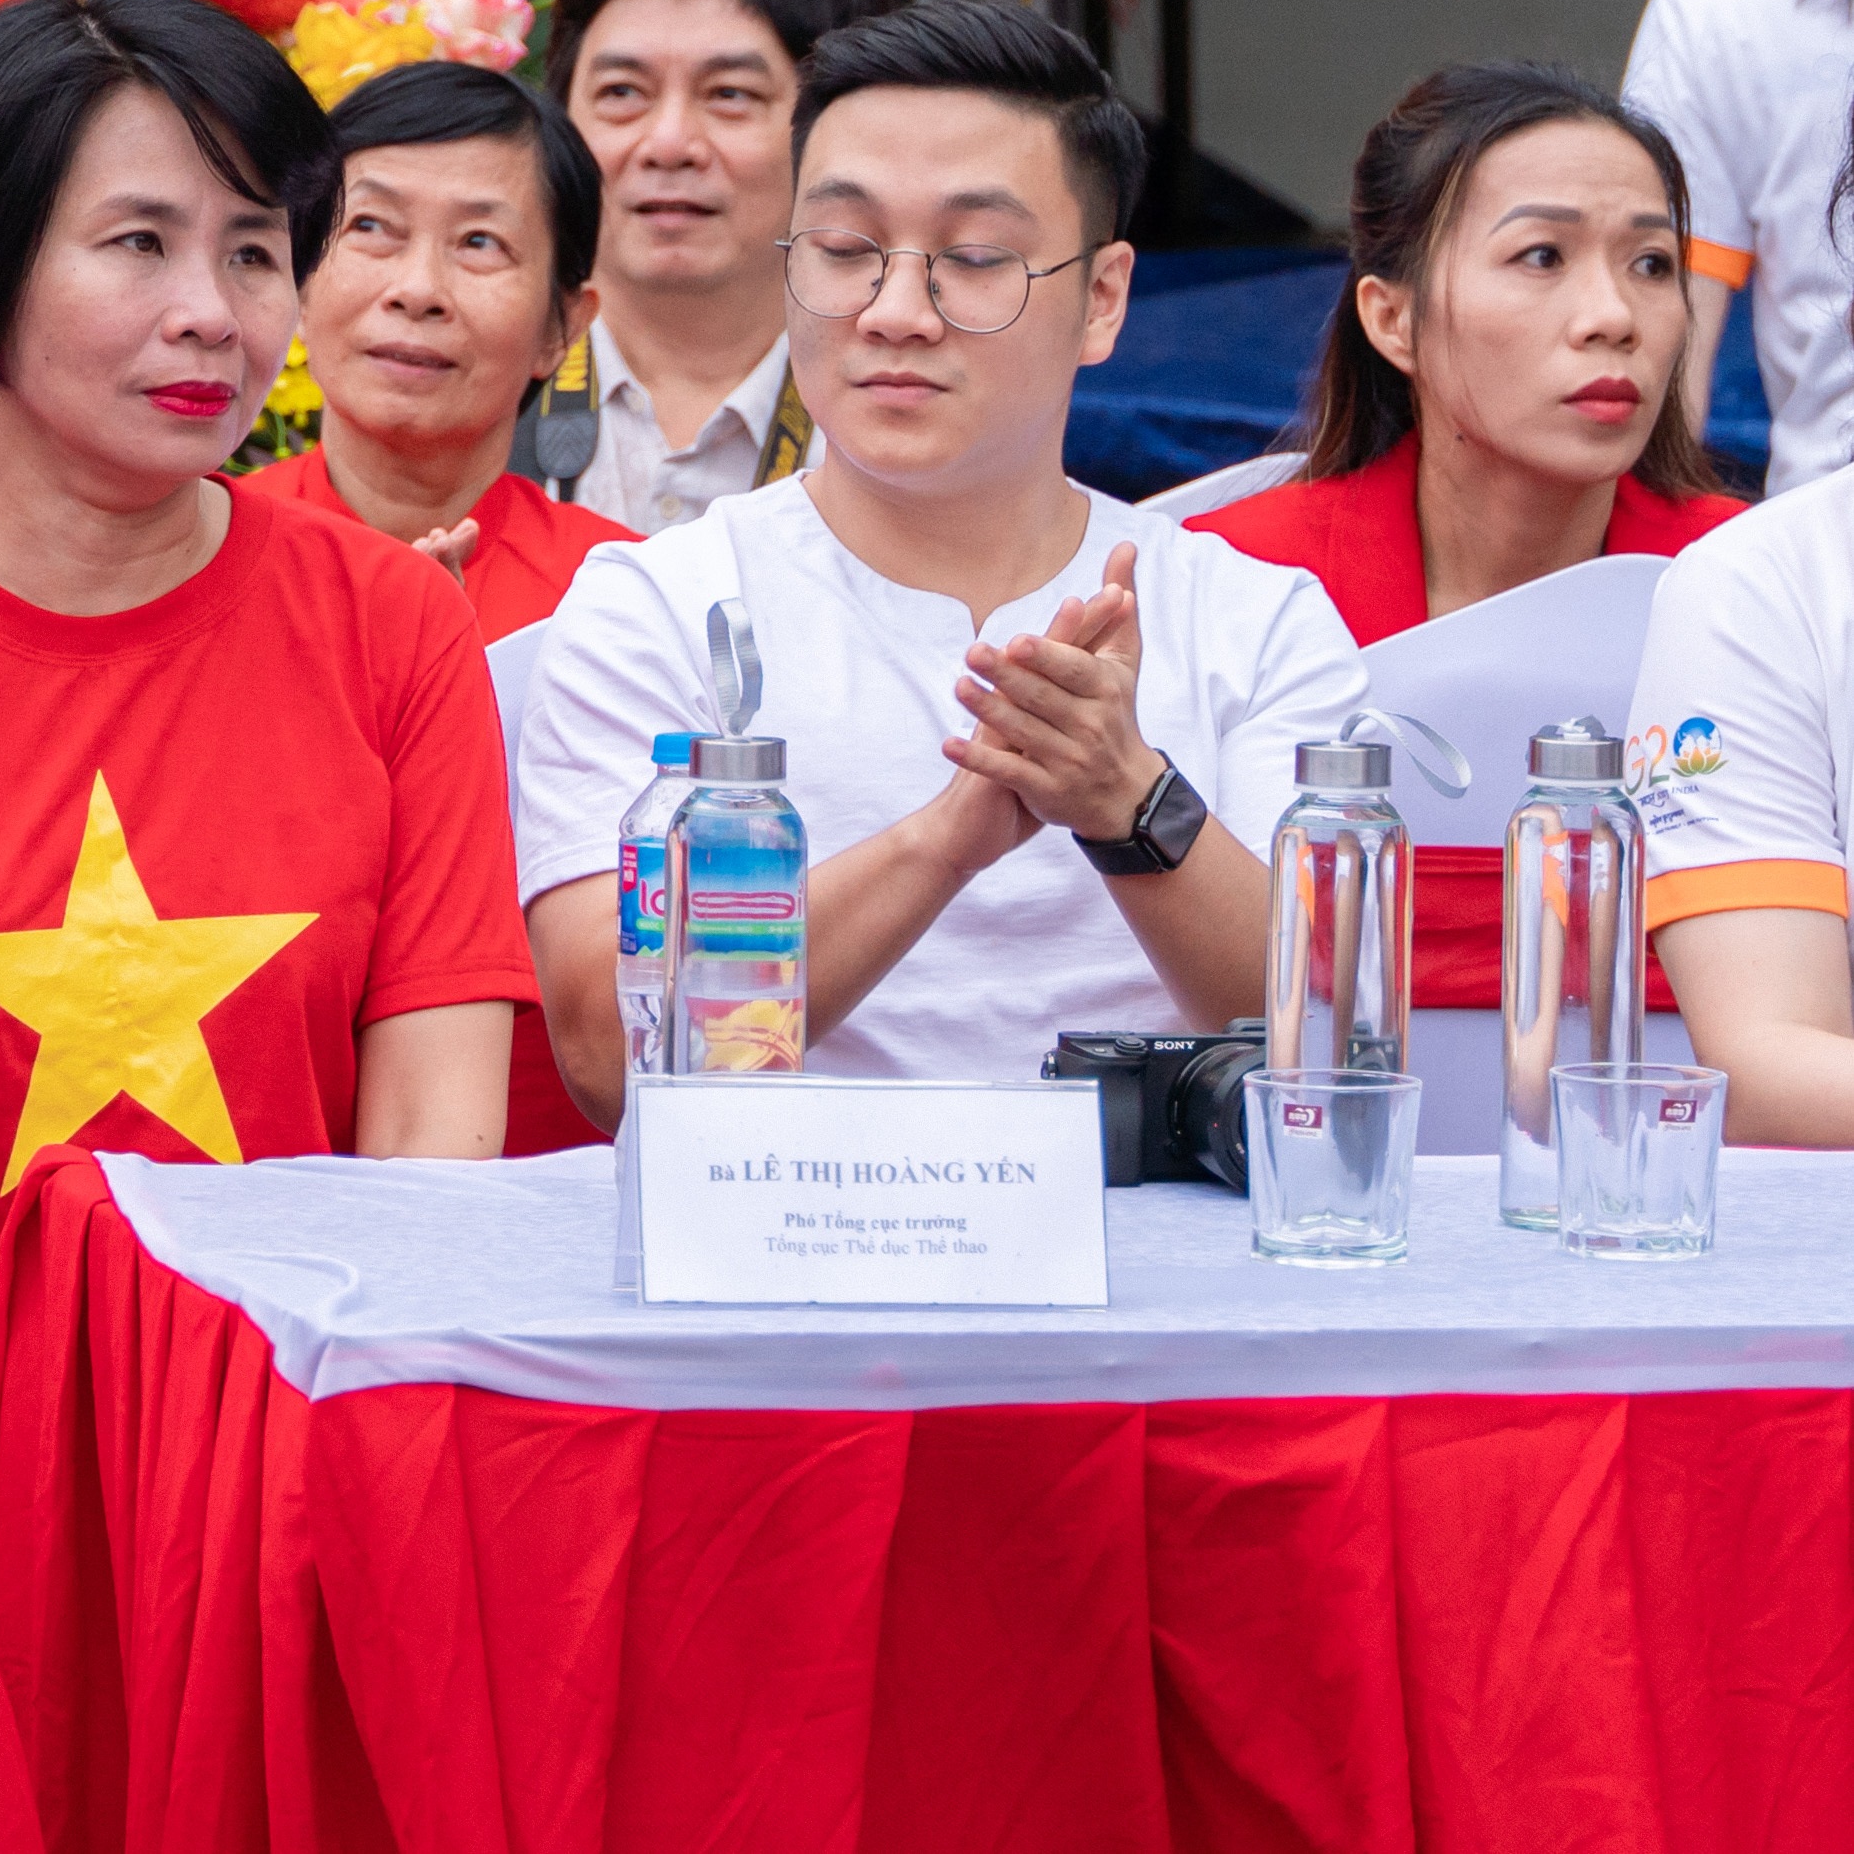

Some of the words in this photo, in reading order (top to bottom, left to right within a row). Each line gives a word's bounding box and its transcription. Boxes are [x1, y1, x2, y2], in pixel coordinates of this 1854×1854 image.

[1153, 1040, 1197, 1051] SONY
[708, 1163, 735, 1183] Bà
[742, 1153, 782, 1183] LÊ
[790, 1160, 843, 1189] THỊ
[852, 1156, 966, 1185] HOÀNG
[974, 1155, 1037, 1184] YẾN
[784, 1212, 817, 1228] Phó
[821, 1209, 866, 1234] Tổng
[871, 1217, 899, 1234] cục
[764, 1232, 808, 1256] Tổng
[811, 1242, 839, 1256] cục
[880, 1240, 910, 1257] dục
[952, 1238, 989, 1255] thao
